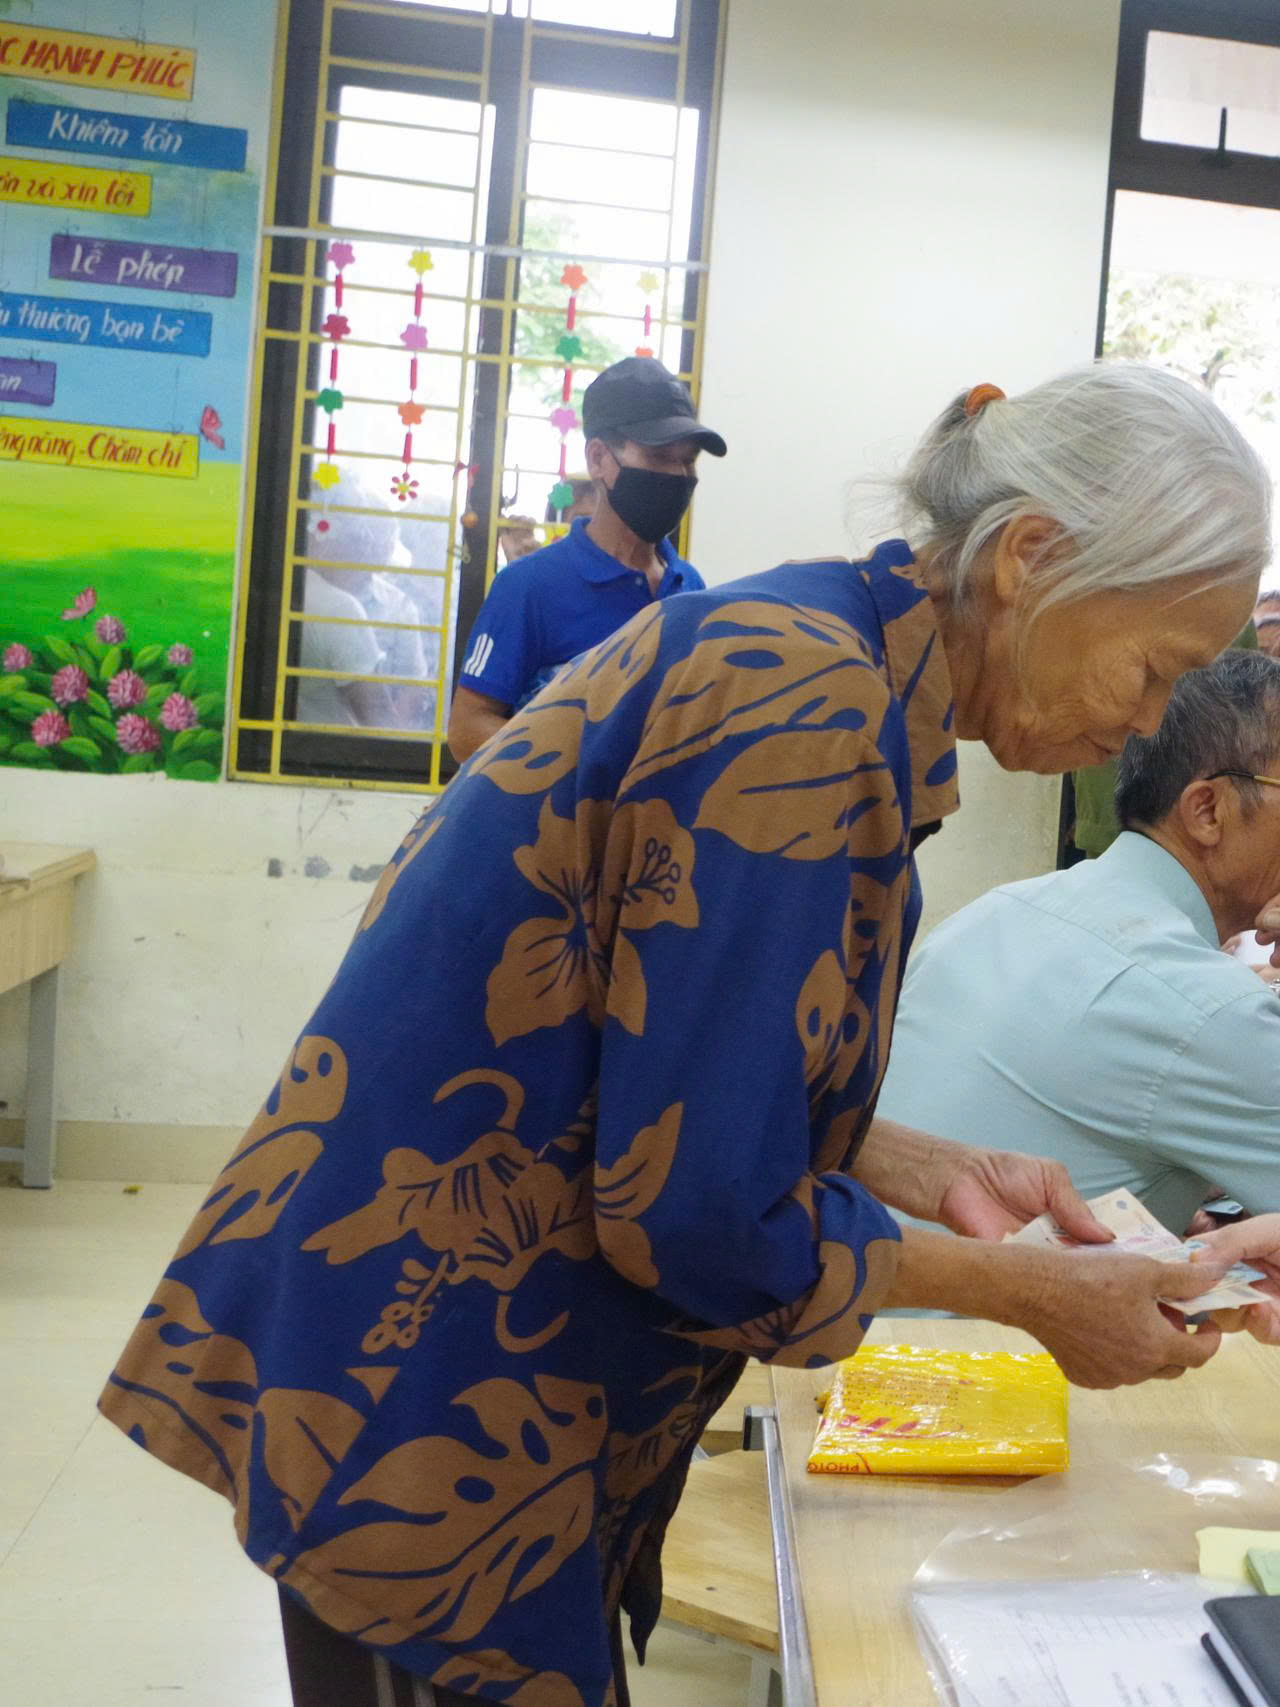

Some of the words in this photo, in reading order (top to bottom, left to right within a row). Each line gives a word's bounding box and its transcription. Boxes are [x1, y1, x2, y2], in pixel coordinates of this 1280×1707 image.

[21, 39, 105, 76] HẠNH
[107, 51, 191, 88] PHÚC
[48, 110, 129, 148] Khiêm
[142, 121, 183, 155] tốn
[59, 181, 98, 203] xin
[71, 242, 103, 275] Lễ
[117, 250, 185, 288] phép
[18, 300, 91, 343] thương
[101, 307, 145, 344] bạn
[151, 313, 185, 343] bè
[88, 432, 143, 464] Chăm
[147, 438, 187, 468] chỉ
